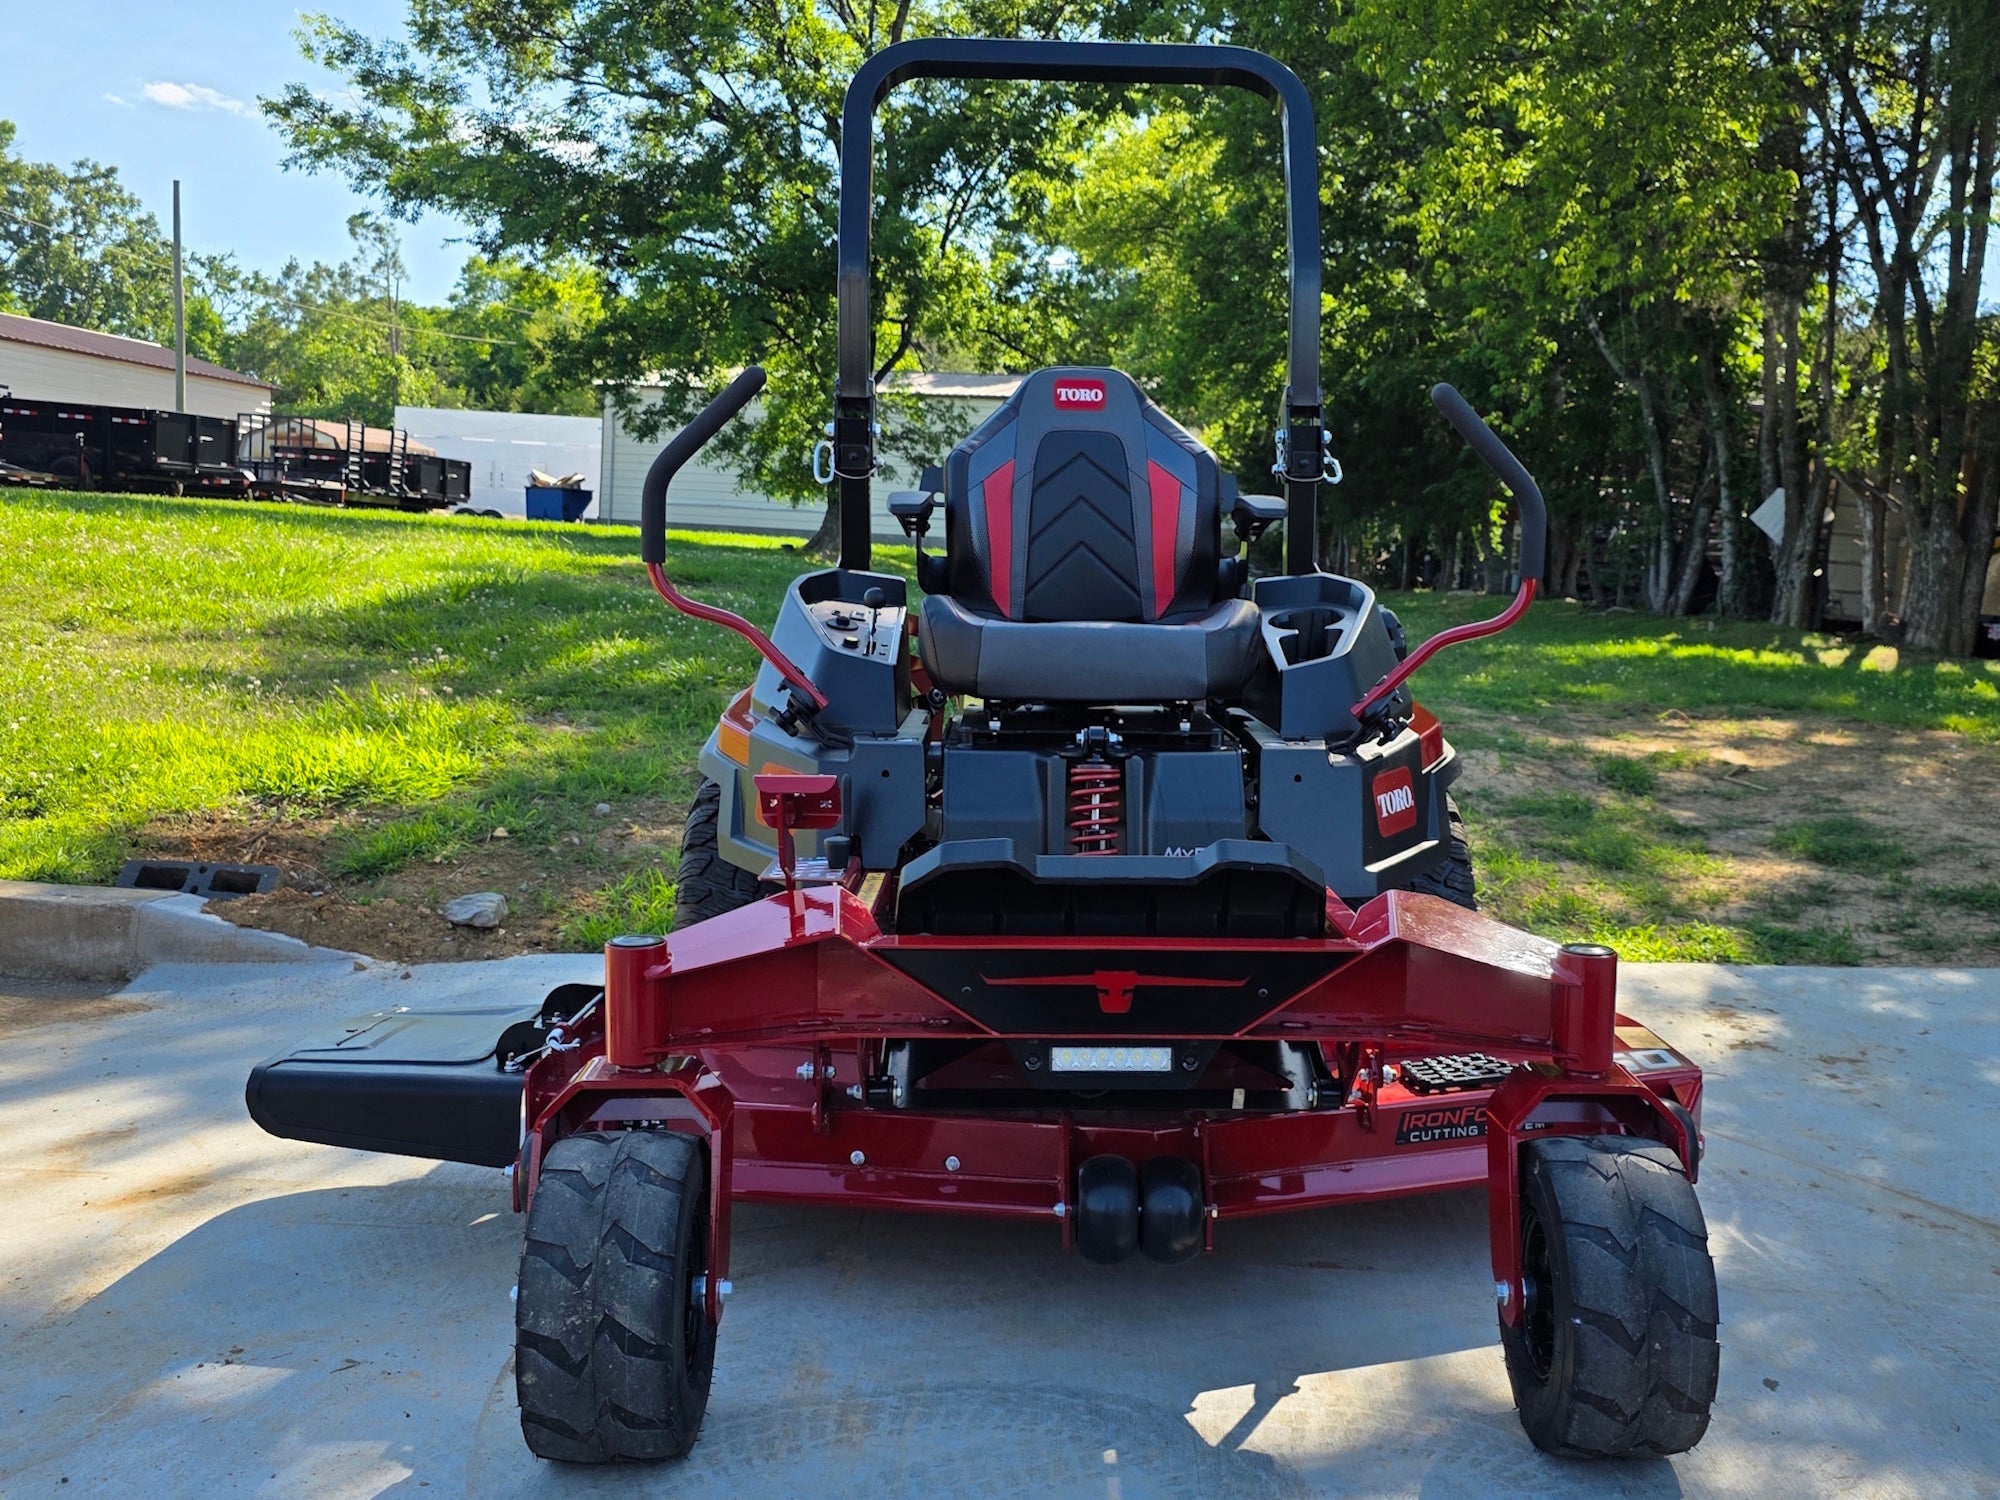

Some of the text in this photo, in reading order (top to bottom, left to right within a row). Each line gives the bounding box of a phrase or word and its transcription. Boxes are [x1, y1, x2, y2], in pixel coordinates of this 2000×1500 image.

[1056, 388, 1103, 402] TORO
[1377, 785, 1413, 818] TORO
[1402, 1106, 1487, 1133] IRONFO
[1409, 1125, 1479, 1143] CUTTING
